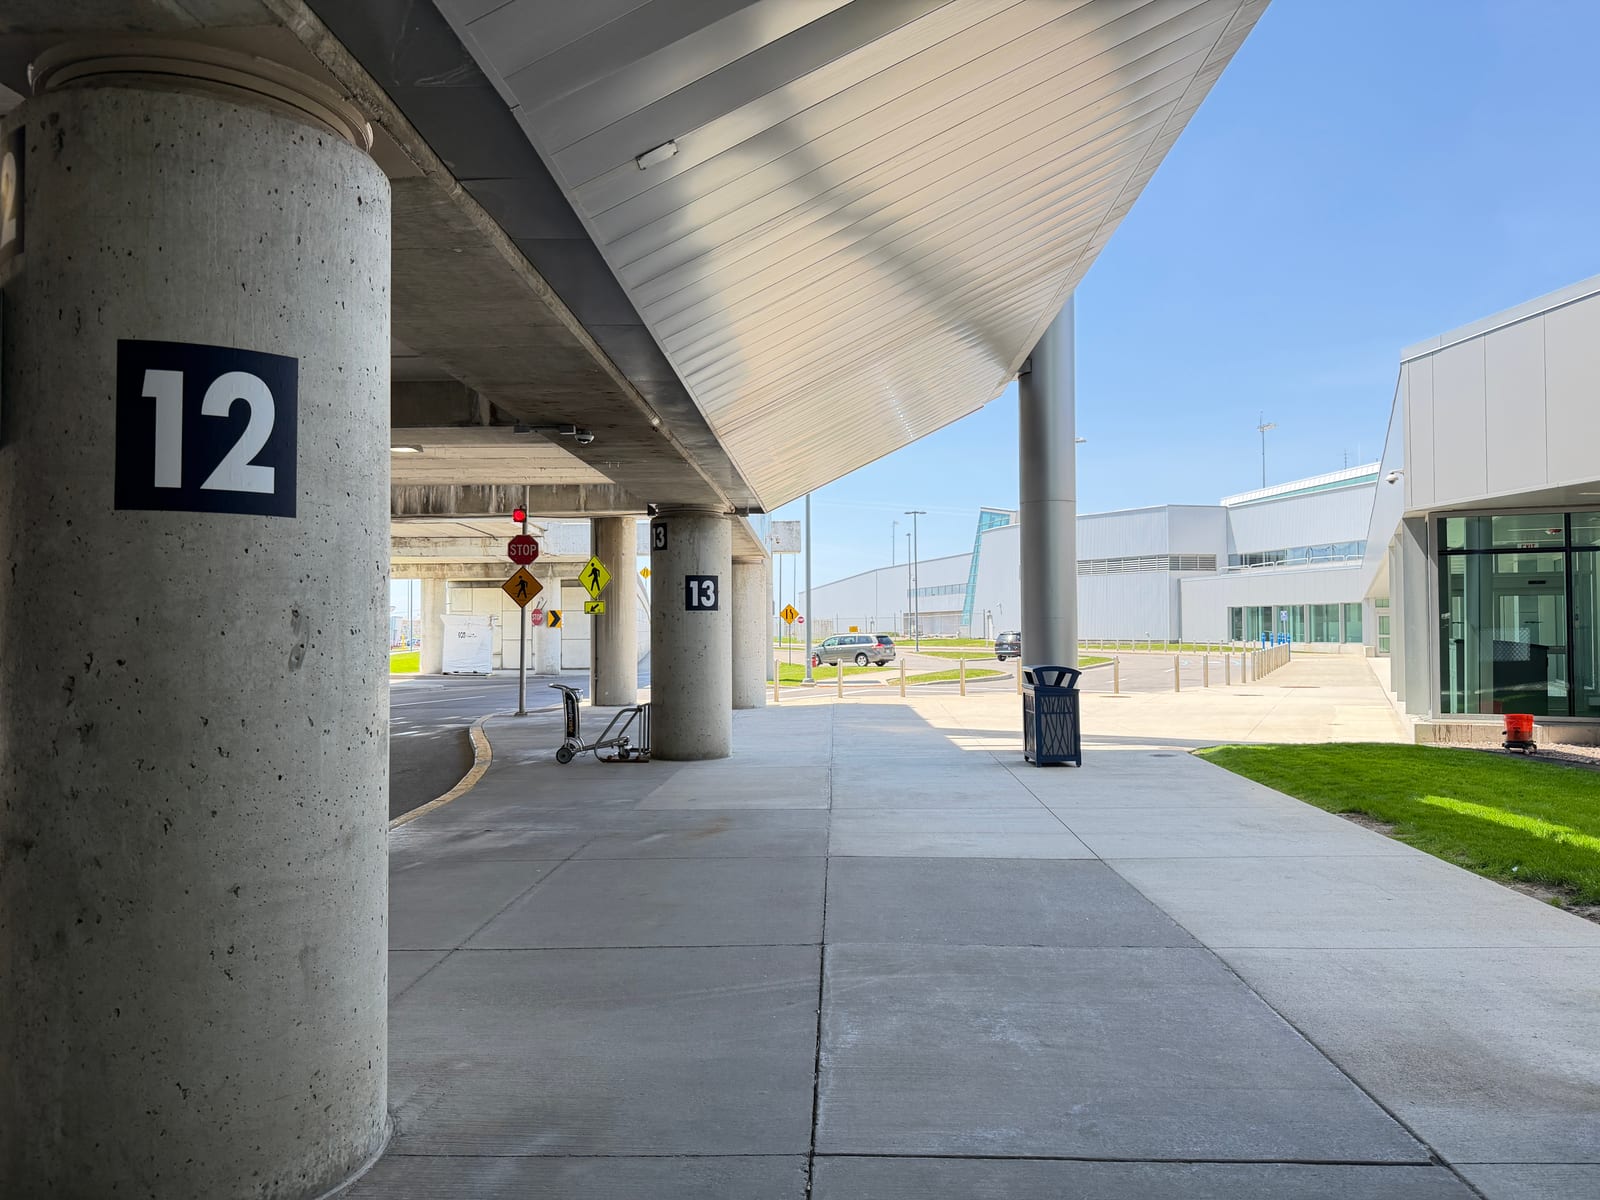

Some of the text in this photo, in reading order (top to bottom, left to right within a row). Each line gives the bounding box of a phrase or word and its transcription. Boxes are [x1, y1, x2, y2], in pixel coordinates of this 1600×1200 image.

[1, 151, 17, 248] 2
[141, 369, 276, 495] 12
[510, 544, 537, 556] STOP
[689, 580, 715, 607] 13
[532, 613, 543, 621] STOP
